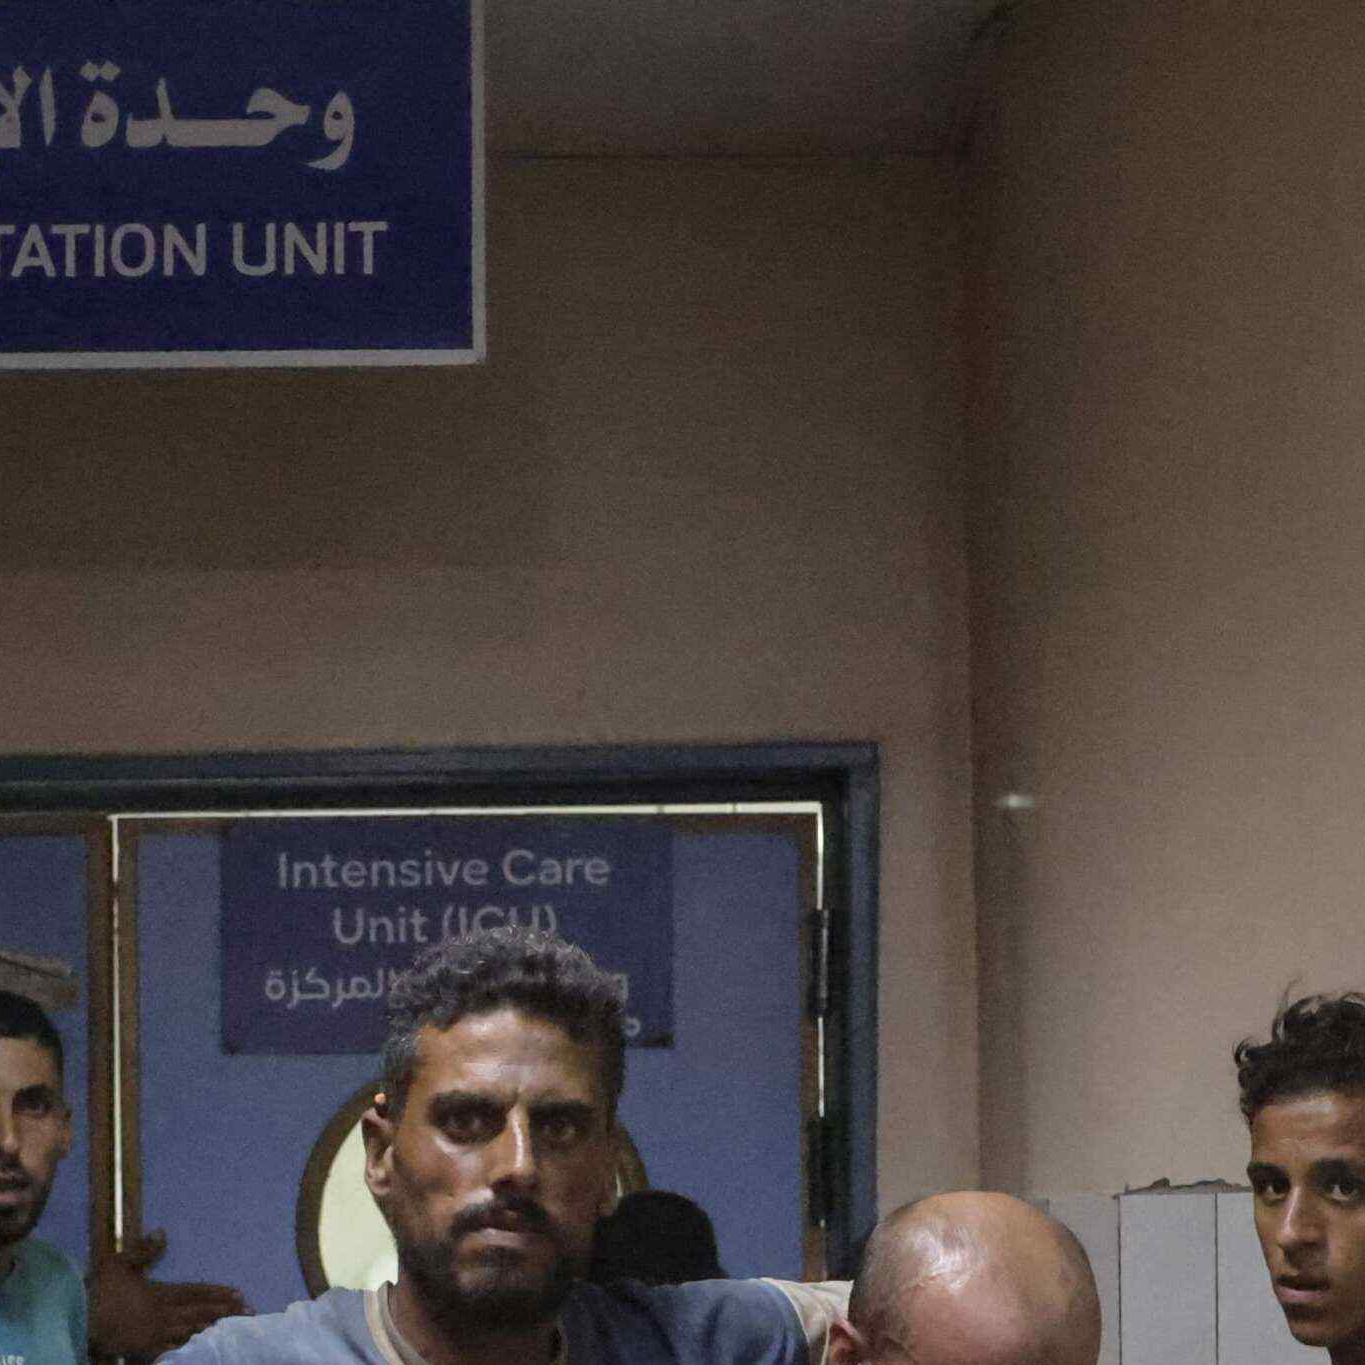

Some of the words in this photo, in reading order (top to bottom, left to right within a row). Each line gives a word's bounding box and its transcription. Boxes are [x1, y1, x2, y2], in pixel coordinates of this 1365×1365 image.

[232, 221, 389, 277] UNIT
[278, 850, 490, 890] Intensive
[501, 848, 612, 887] Care
[332, 905, 429, 946] Unit
